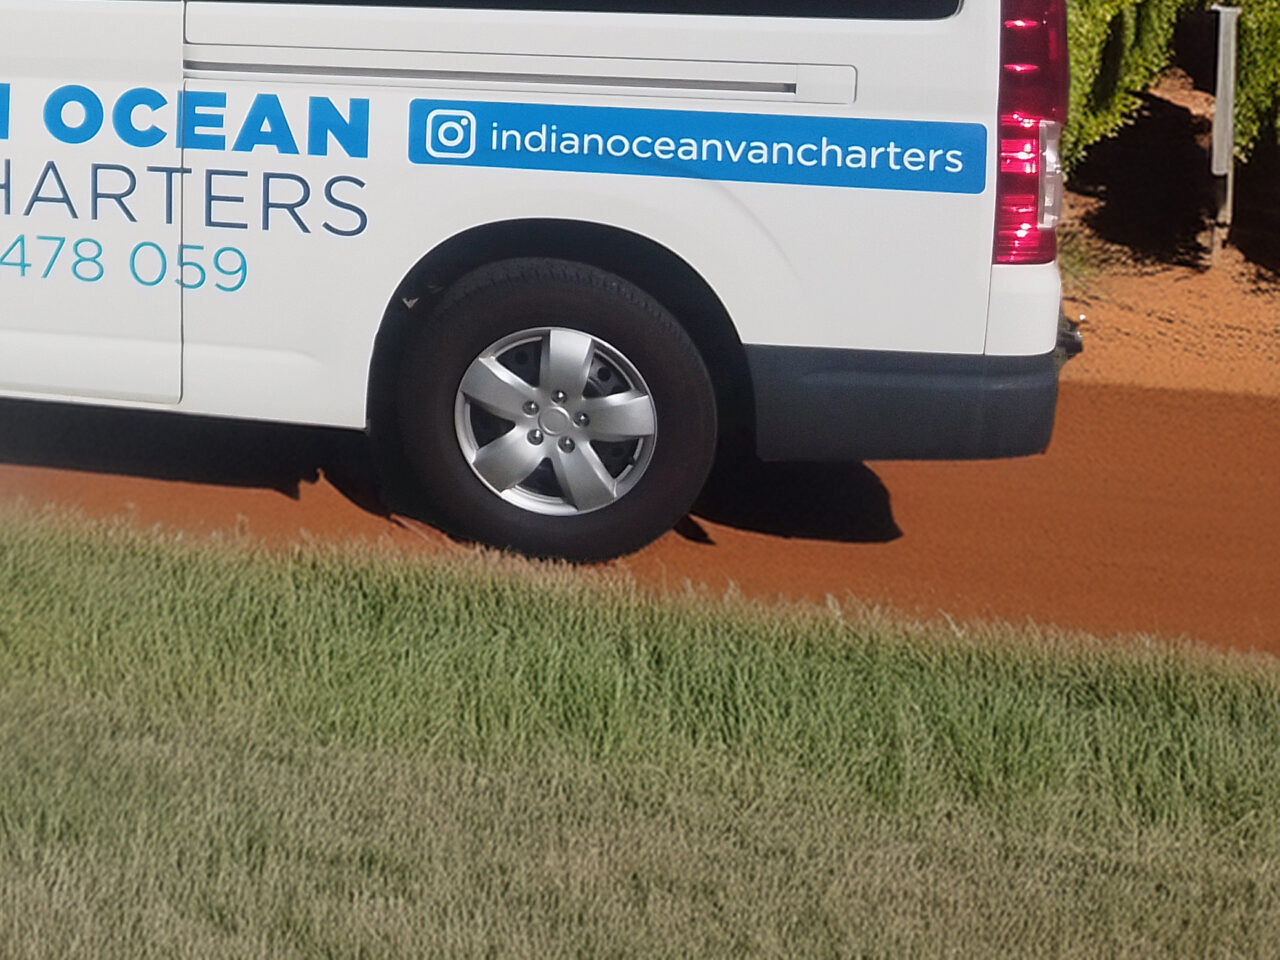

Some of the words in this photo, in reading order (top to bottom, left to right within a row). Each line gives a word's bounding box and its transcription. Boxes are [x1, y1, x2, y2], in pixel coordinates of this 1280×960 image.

[42, 84, 371, 160] OCEAN
[491, 122, 964, 174] indianoceanvancharters
[128, 240, 249, 293] 059
